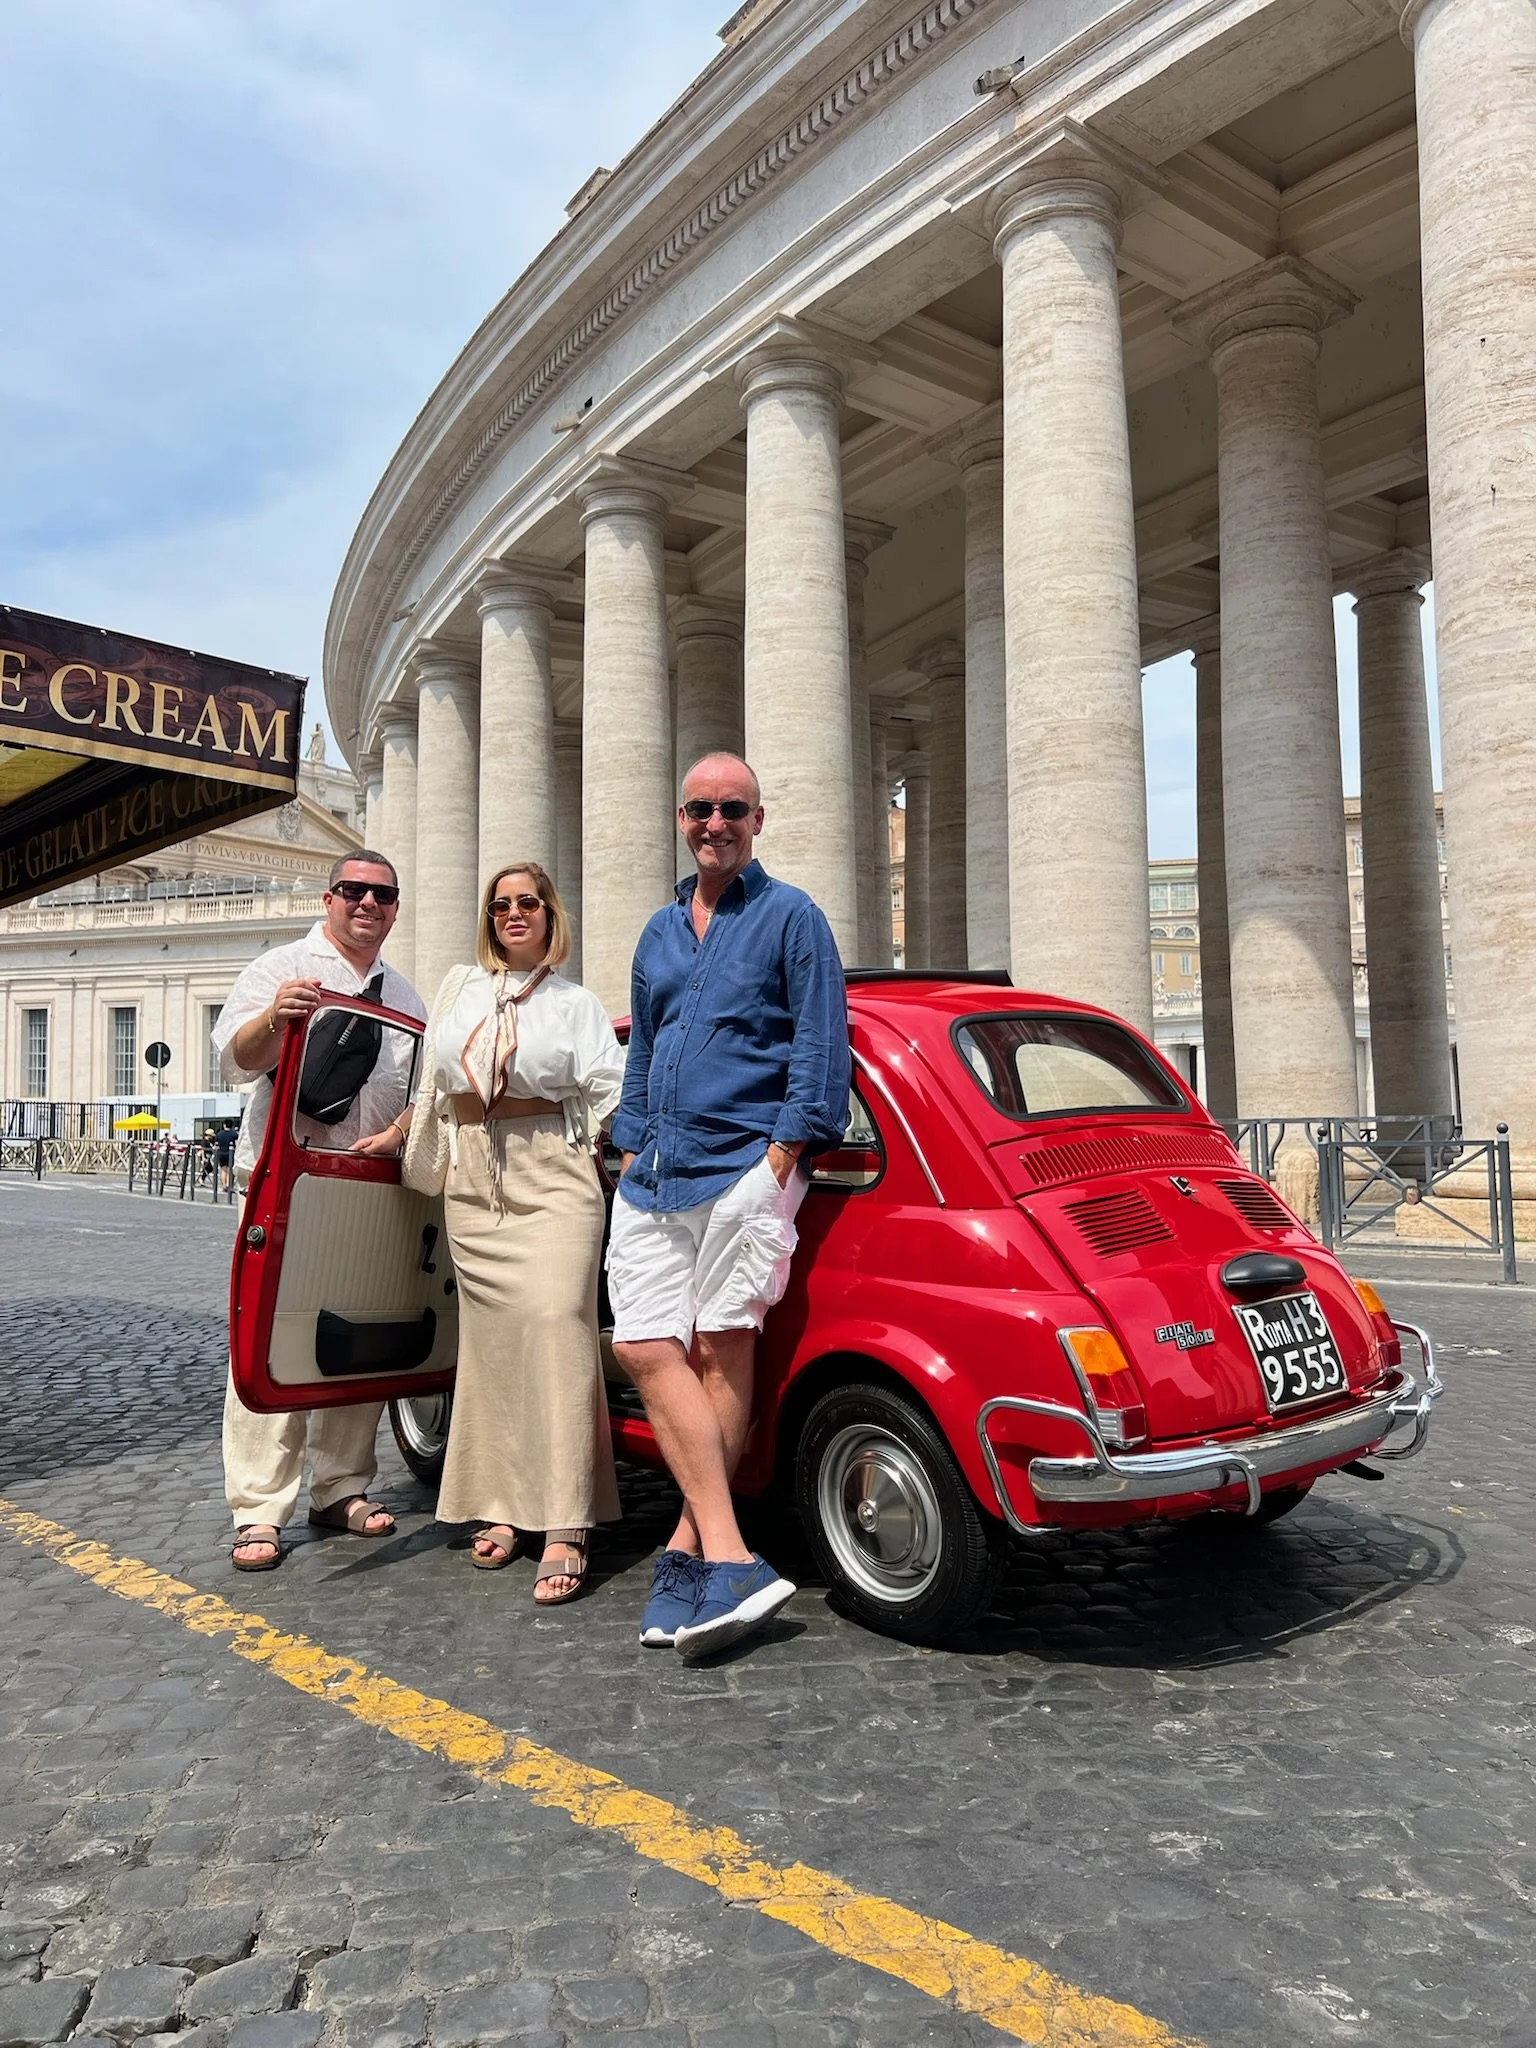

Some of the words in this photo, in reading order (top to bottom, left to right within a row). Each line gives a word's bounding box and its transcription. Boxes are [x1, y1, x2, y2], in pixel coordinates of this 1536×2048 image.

[48, 663, 290, 764] CREAM
[25, 803, 110, 880] GELATI
[118, 779, 166, 843] ICE
[198, 844, 238, 859] PAVLVS
[249, 850, 319, 873] BVRGHESIVS
[1157, 1322, 1192, 1341] FIAT
[1179, 1330, 1214, 1347] 500L
[1262, 1341, 1339, 1402] 9555
